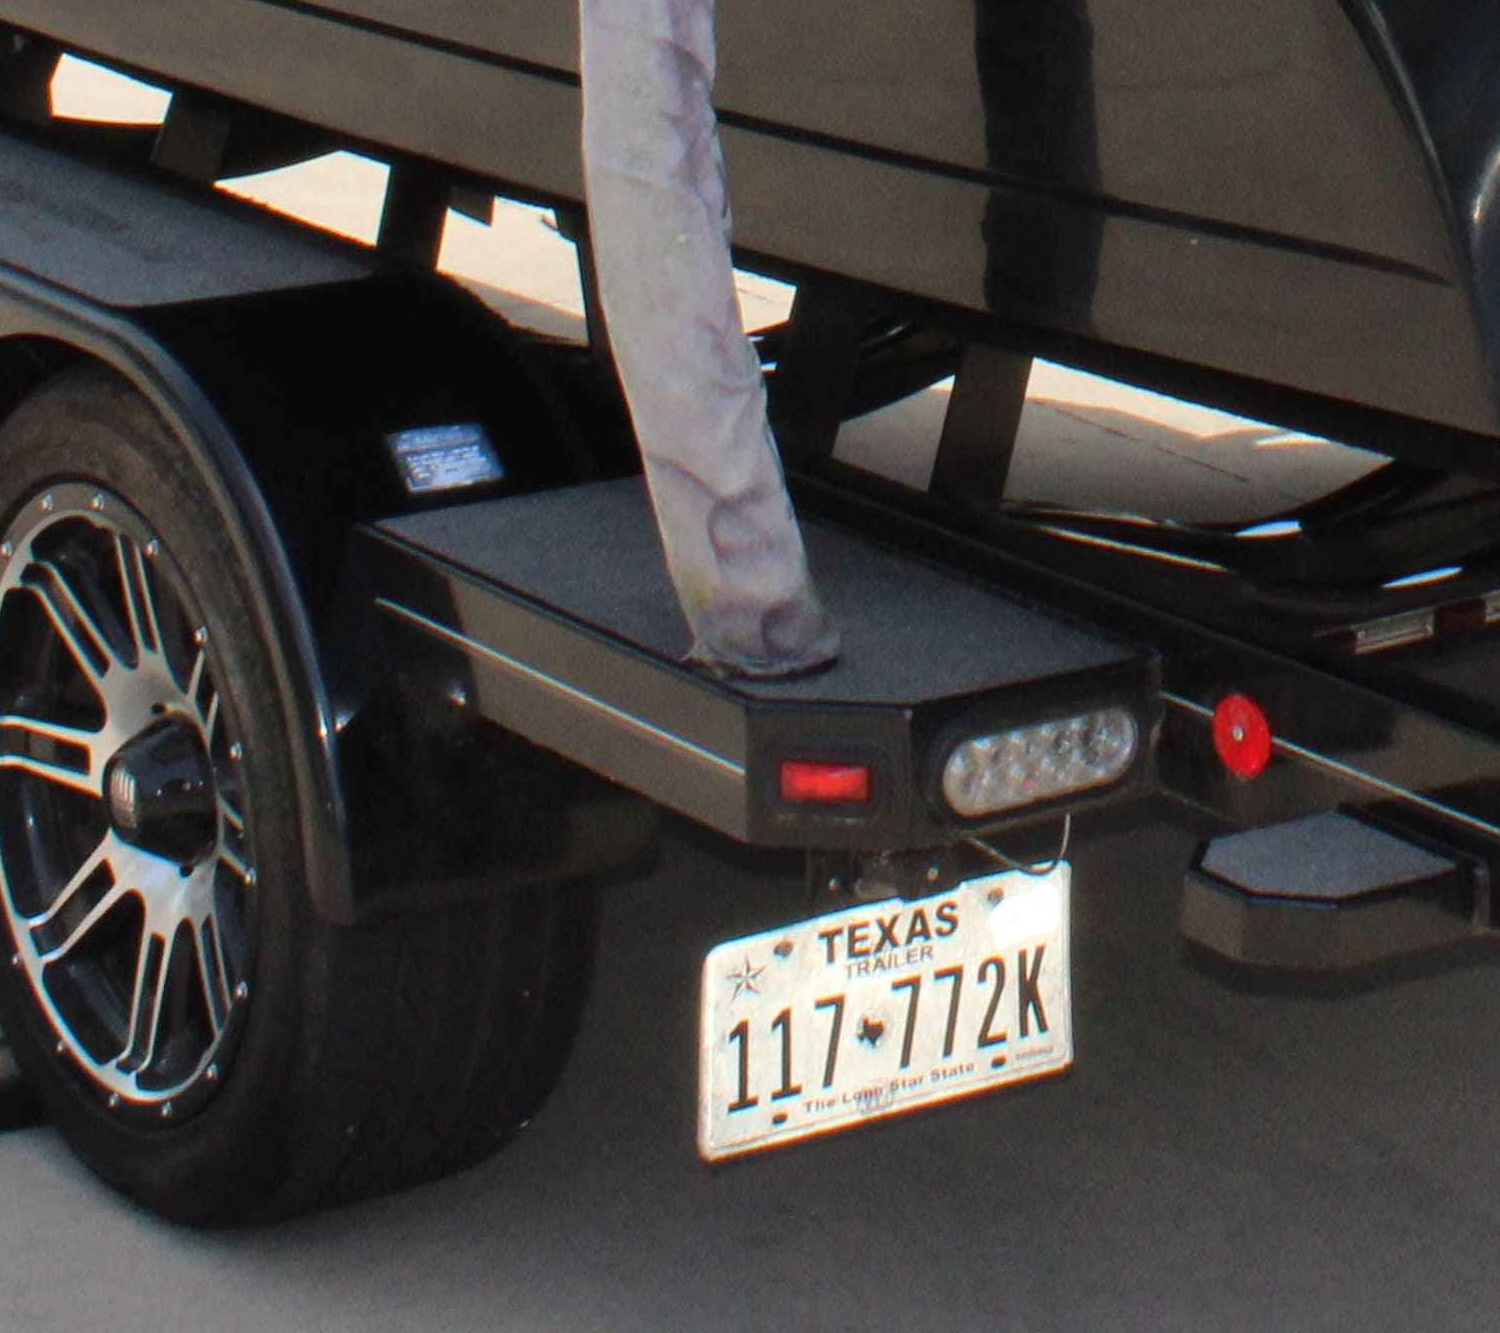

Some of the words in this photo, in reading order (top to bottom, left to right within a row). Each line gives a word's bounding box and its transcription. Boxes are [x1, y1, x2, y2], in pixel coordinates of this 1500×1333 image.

[818, 899, 961, 965] TEXAS
[845, 943, 934, 980] TRAILER
[803, 1096, 837, 1114] The
[889, 1074, 926, 1095] Star
[930, 1062, 976, 1084] State
